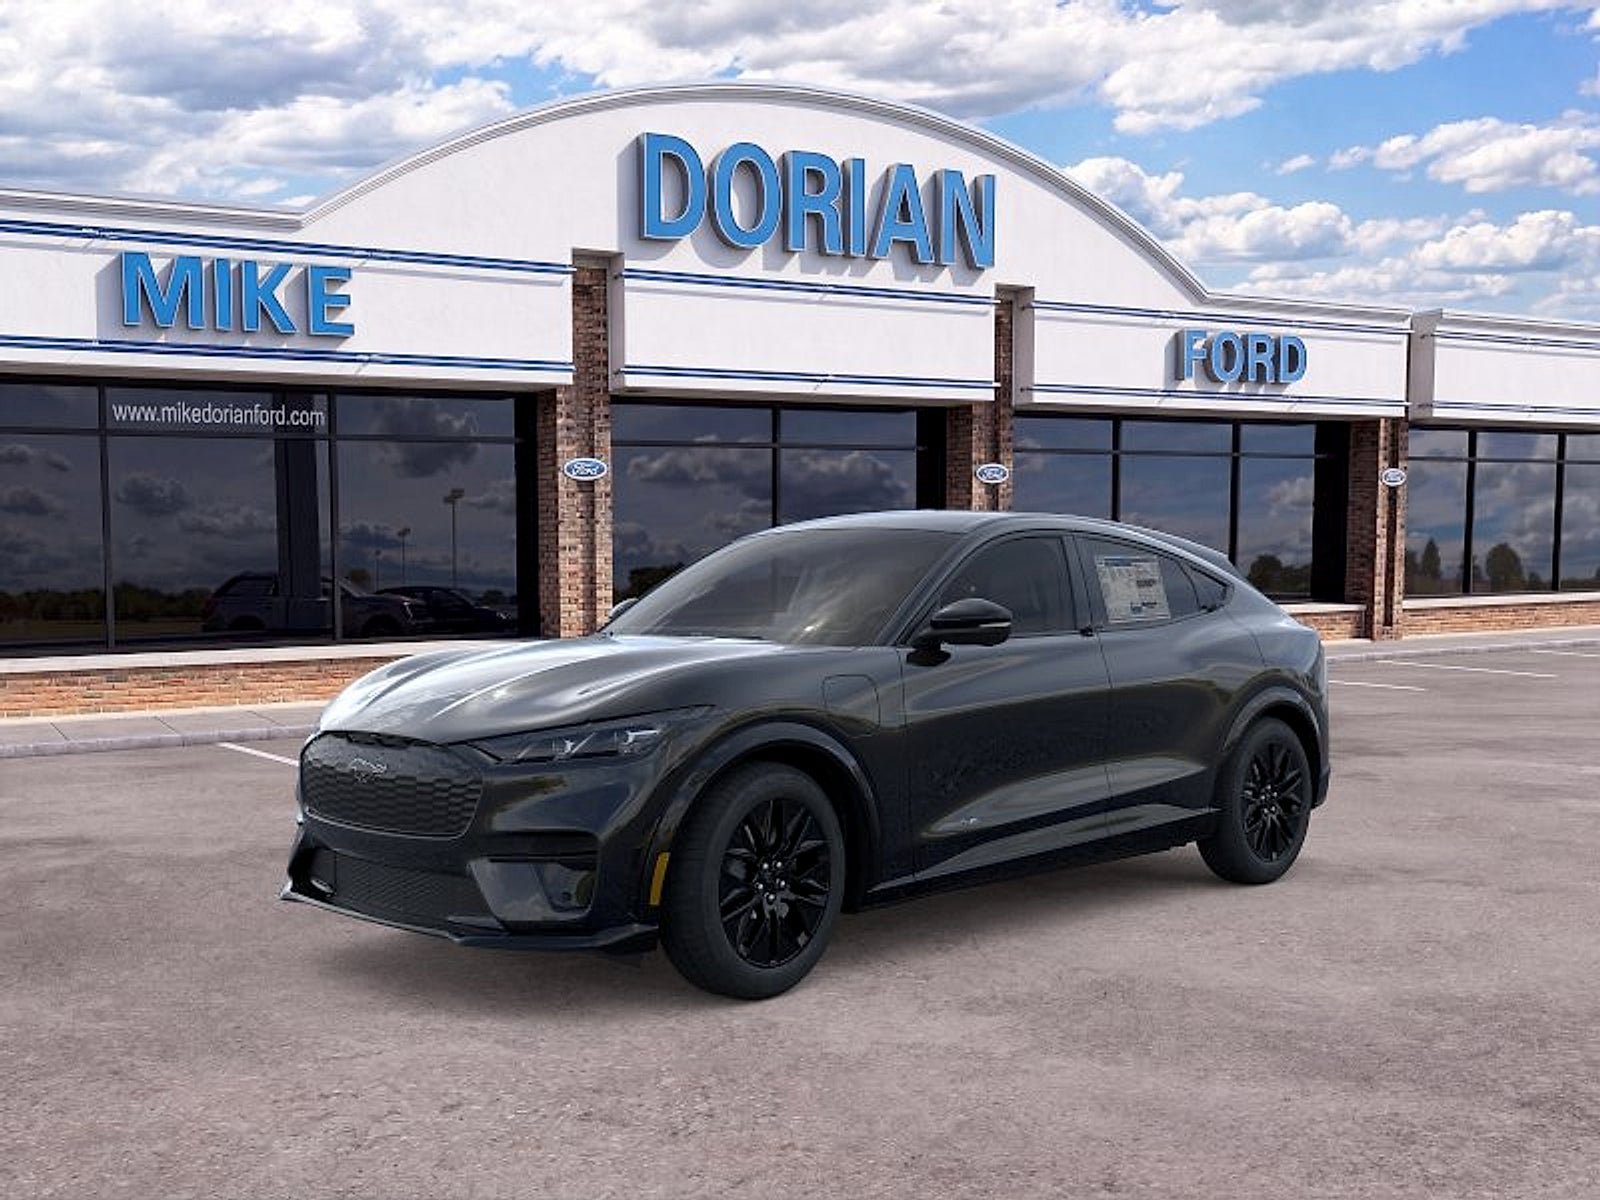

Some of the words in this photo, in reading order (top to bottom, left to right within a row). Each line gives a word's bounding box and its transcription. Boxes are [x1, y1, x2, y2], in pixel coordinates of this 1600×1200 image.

[639, 132, 996, 269] DORIAN
[121, 251, 355, 337] MIKE
[1176, 329, 1308, 384] FORD
[112, 402, 326, 426] www.mikedorianford.com
